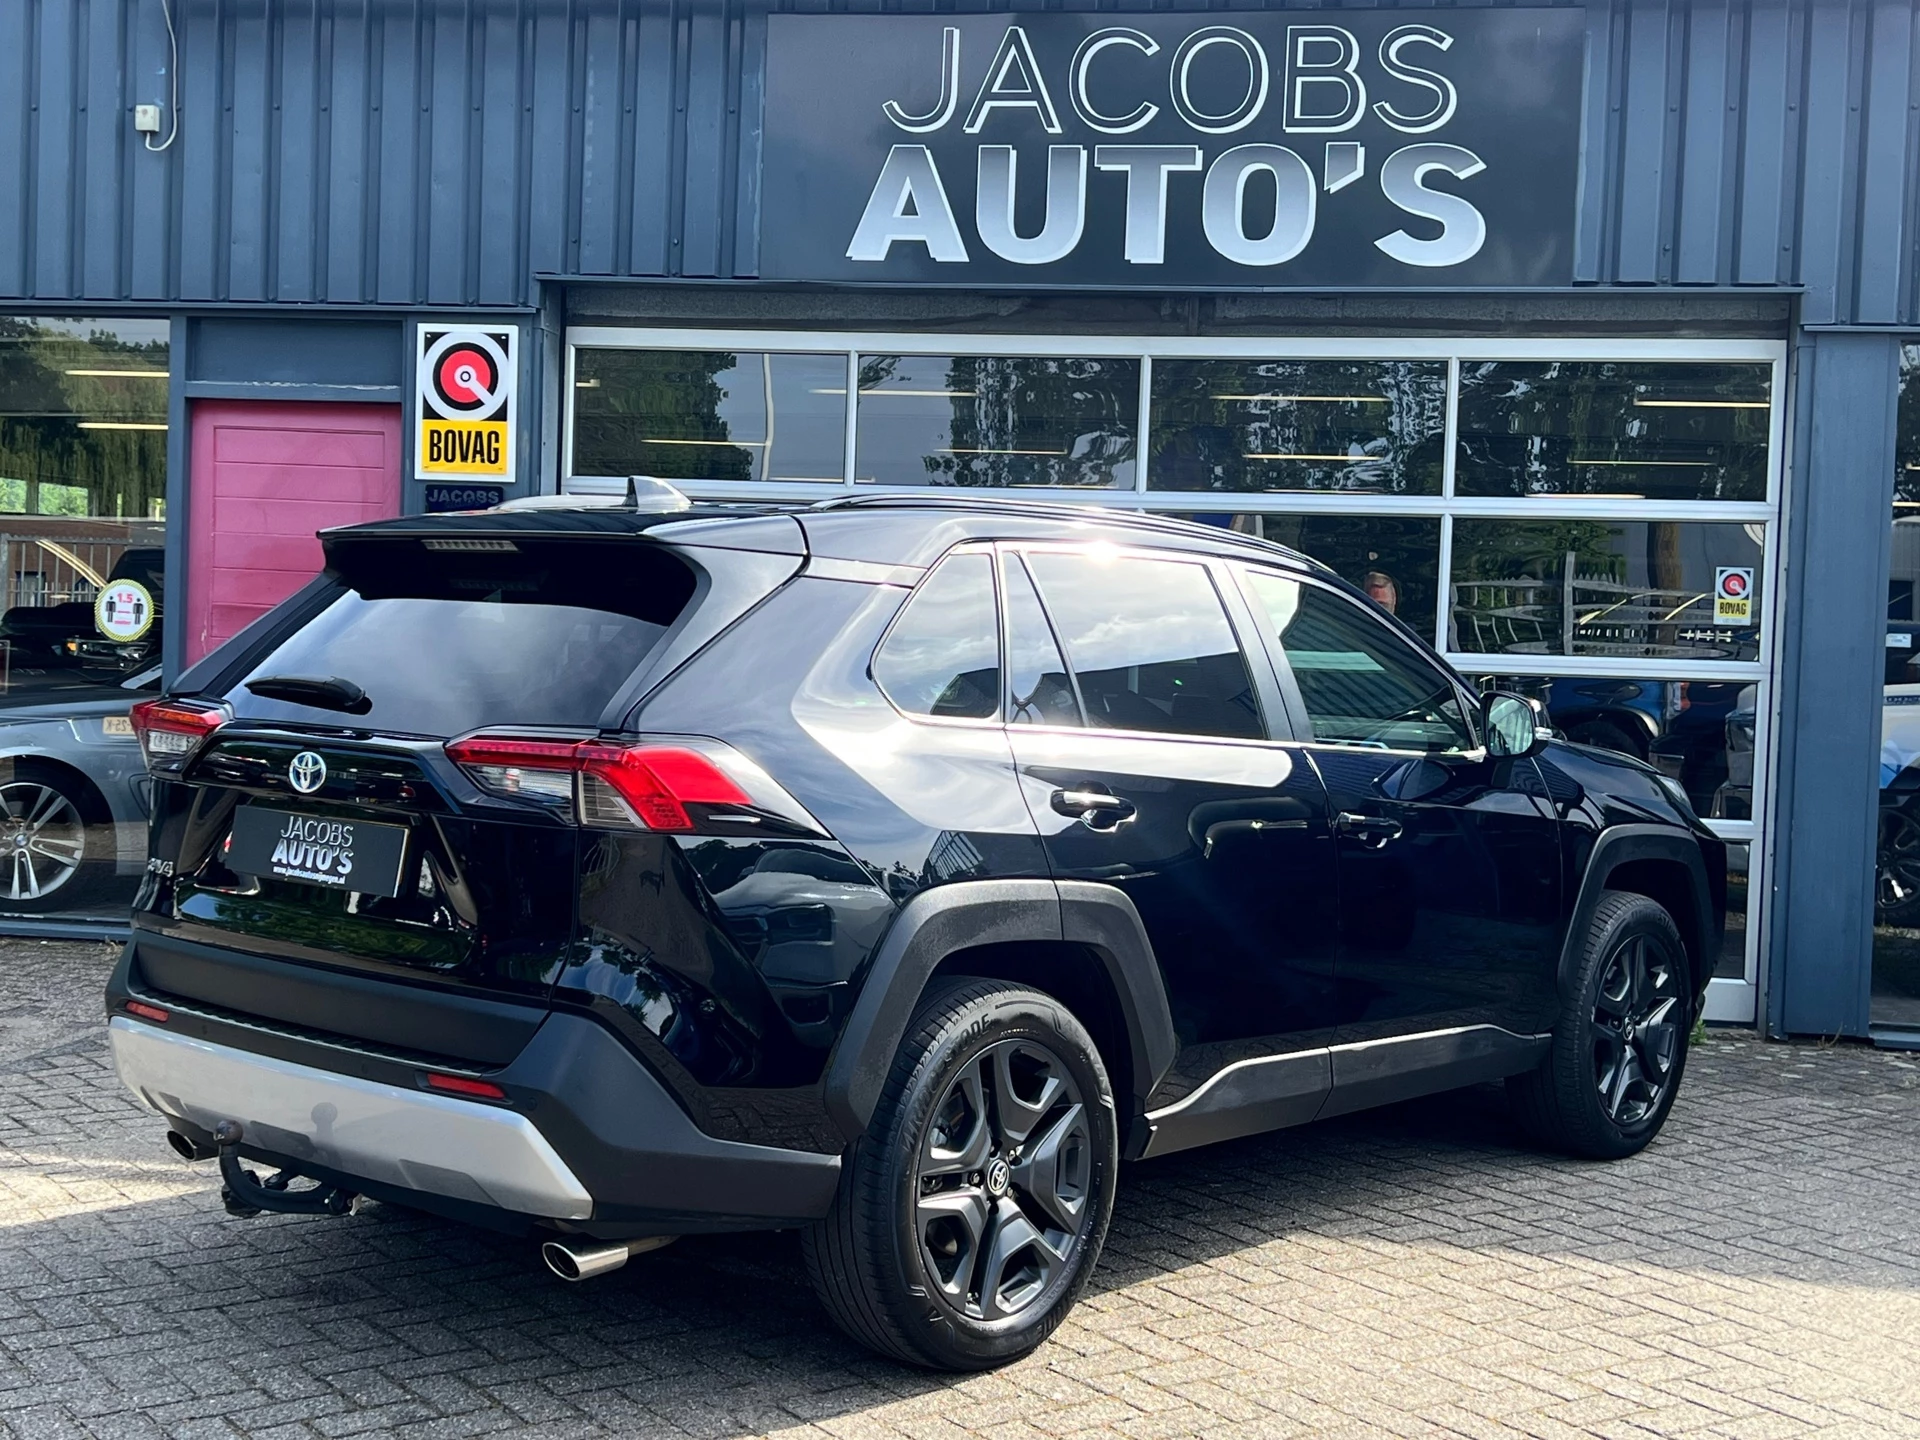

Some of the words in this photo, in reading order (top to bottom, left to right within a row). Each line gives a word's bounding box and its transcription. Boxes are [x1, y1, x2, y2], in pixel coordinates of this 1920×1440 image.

[882, 25, 1457, 133] JACOBS
[845, 142, 1487, 267] AUTO'S
[429, 429, 500, 464] BOVAG
[428, 489, 499, 504] JACOBS
[117, 592, 134, 604] 1.5
[1719, 602, 1747, 615] BOVAG
[280, 816, 354, 848] JACOBS
[271, 838, 354, 875] AUTO'S
